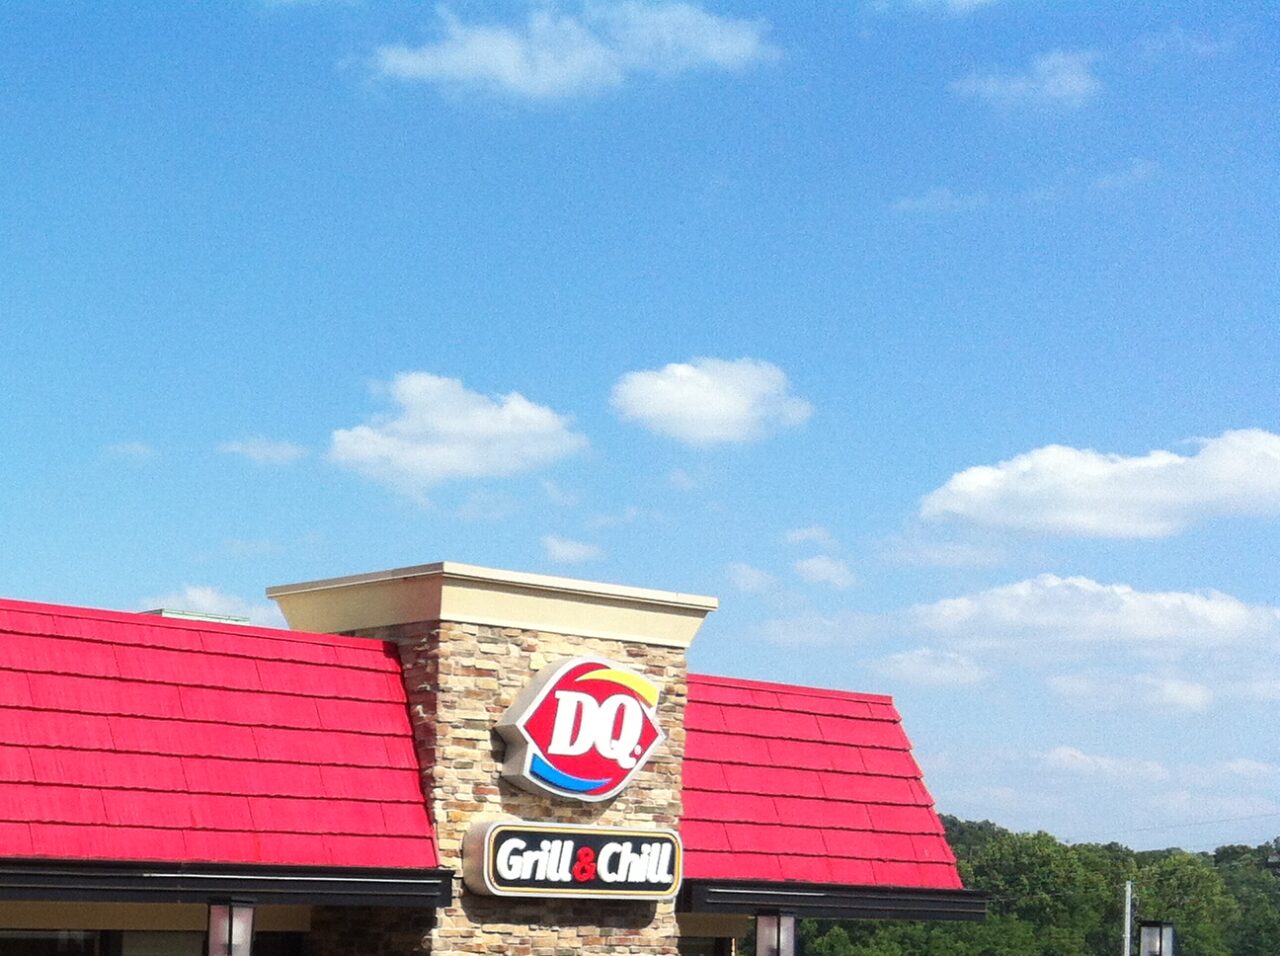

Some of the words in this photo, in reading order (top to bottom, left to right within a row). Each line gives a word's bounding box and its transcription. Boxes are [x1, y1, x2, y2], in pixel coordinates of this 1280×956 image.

[547, 690, 644, 769] DQ
[496, 838, 574, 882] Grill
[573, 847, 597, 882] &
[597, 841, 673, 883] Chill
